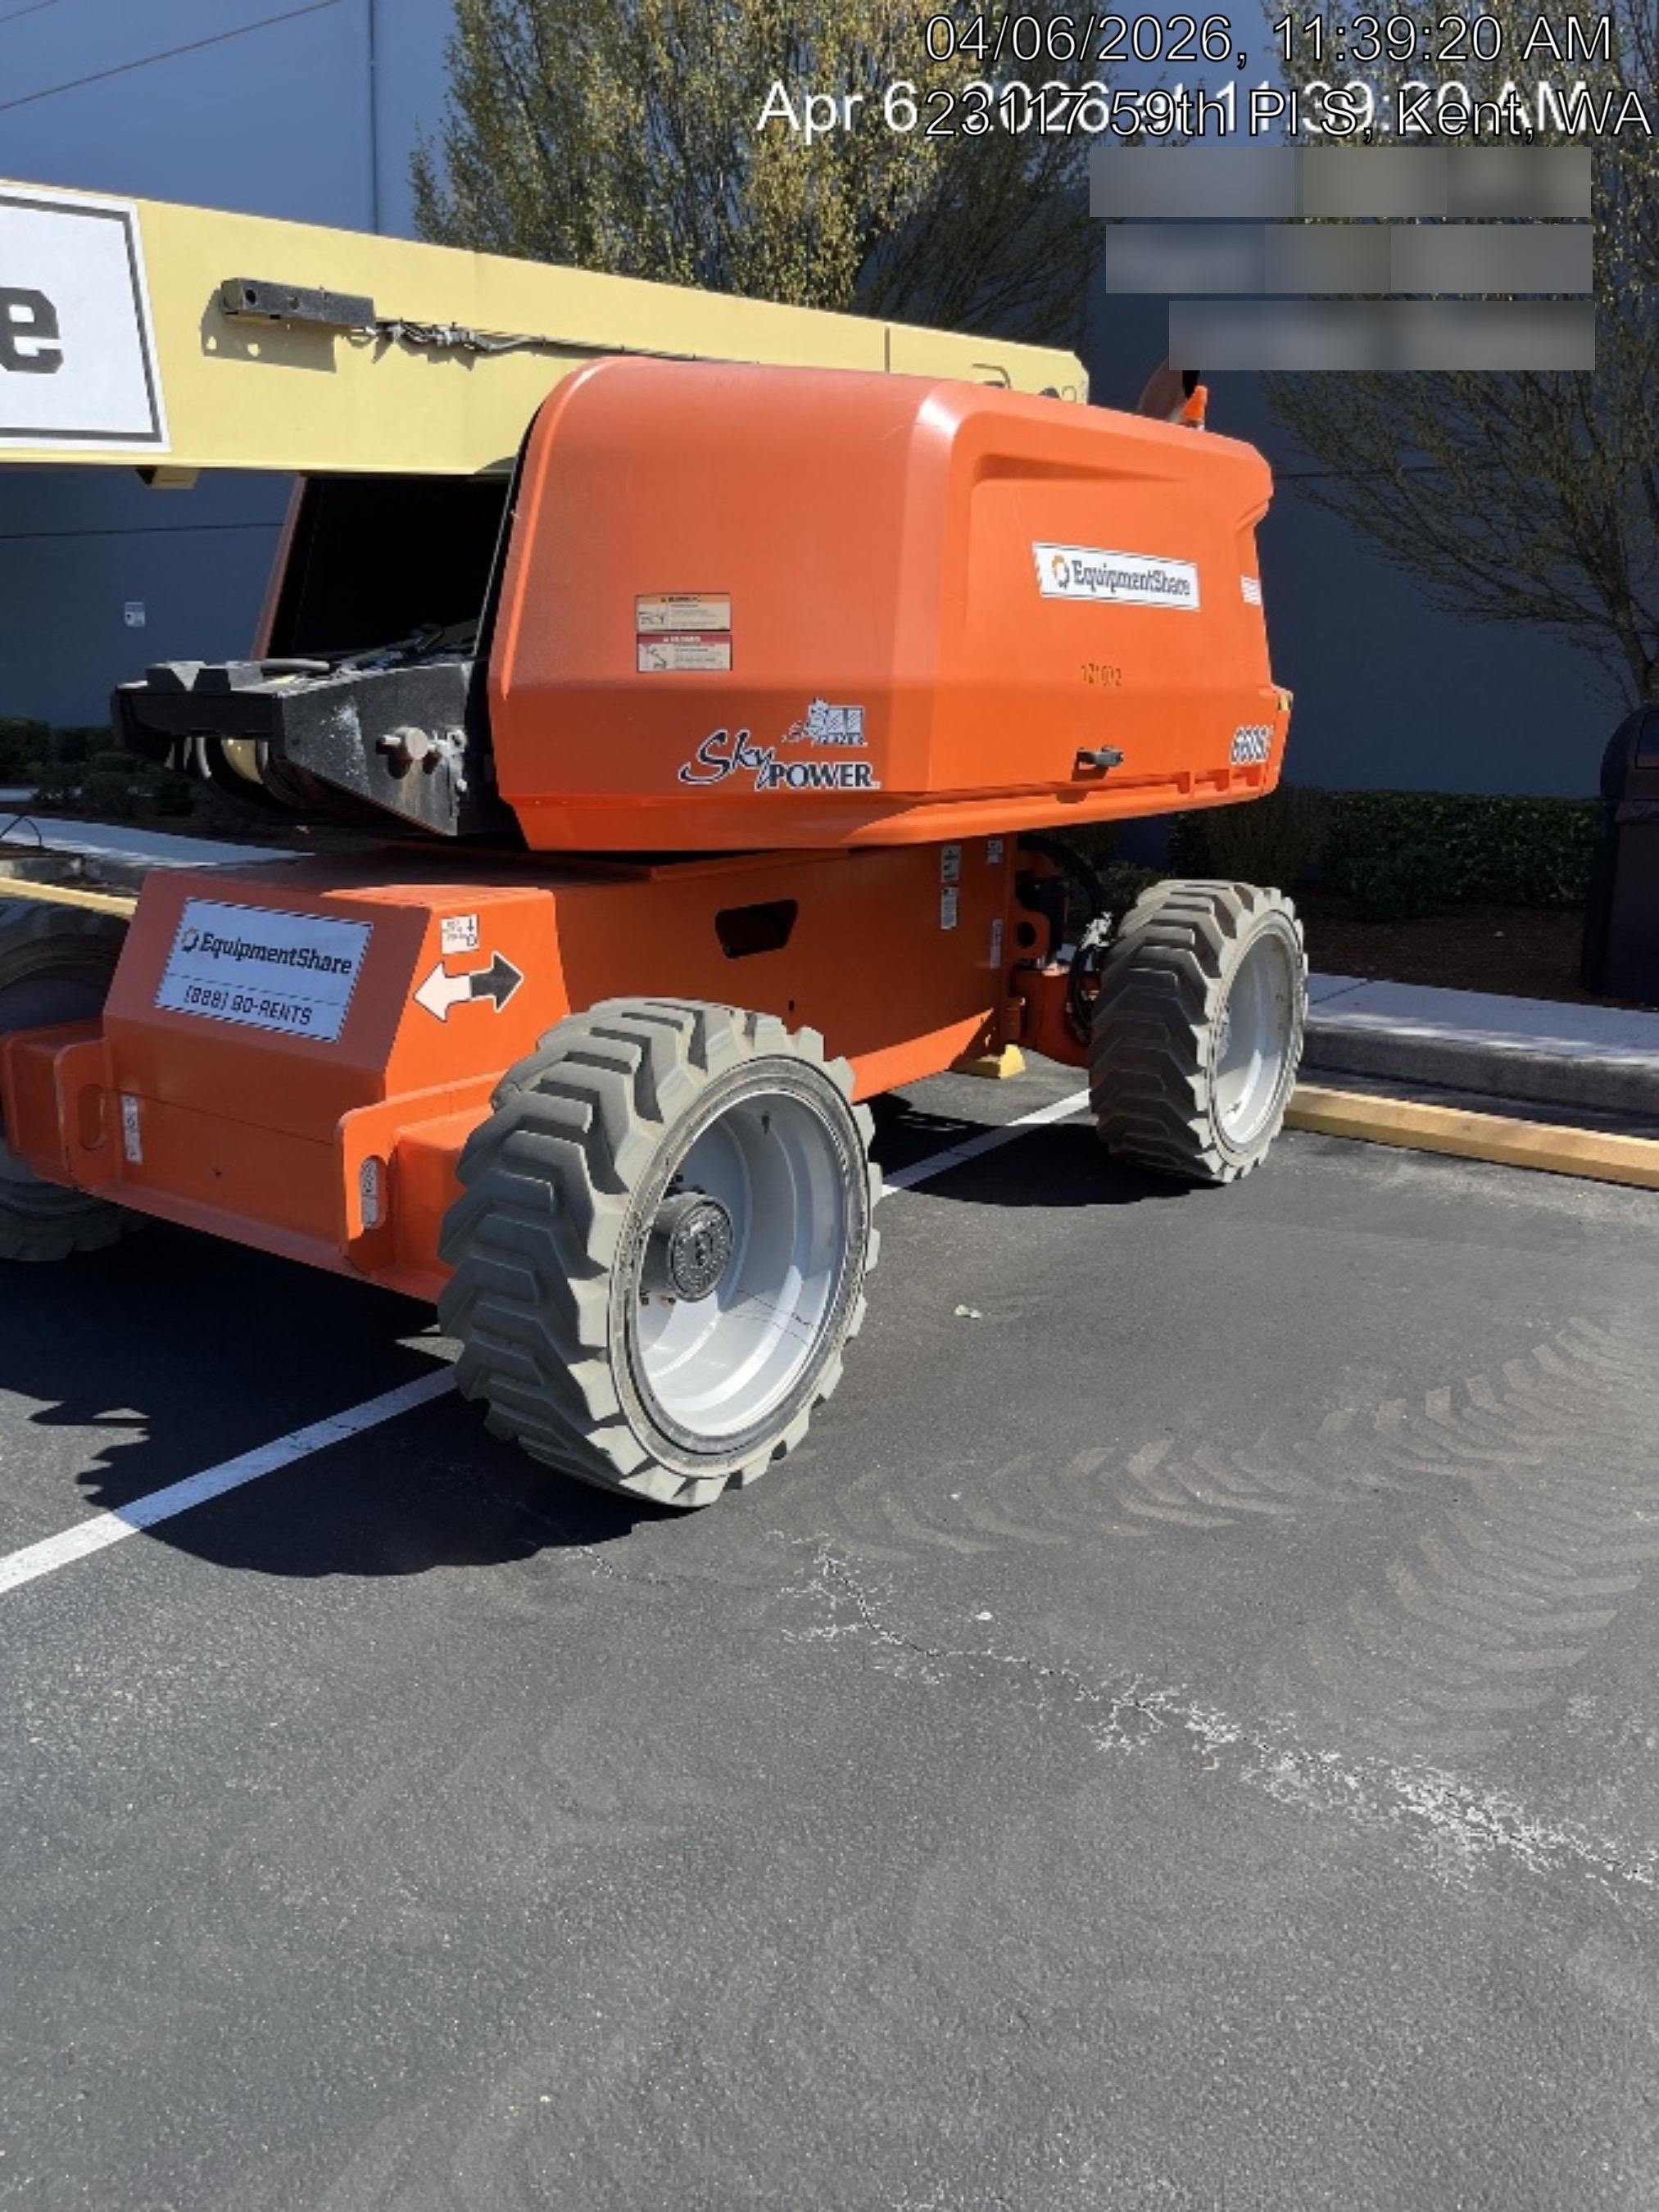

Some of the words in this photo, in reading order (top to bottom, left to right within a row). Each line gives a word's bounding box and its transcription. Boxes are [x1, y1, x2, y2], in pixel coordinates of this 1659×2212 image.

[1071, 559, 1191, 596] EquipmentShare
[678, 730, 775, 791] Sky
[767, 762, 873, 787] POWER
[199, 932, 352, 974] EquipmentShare
